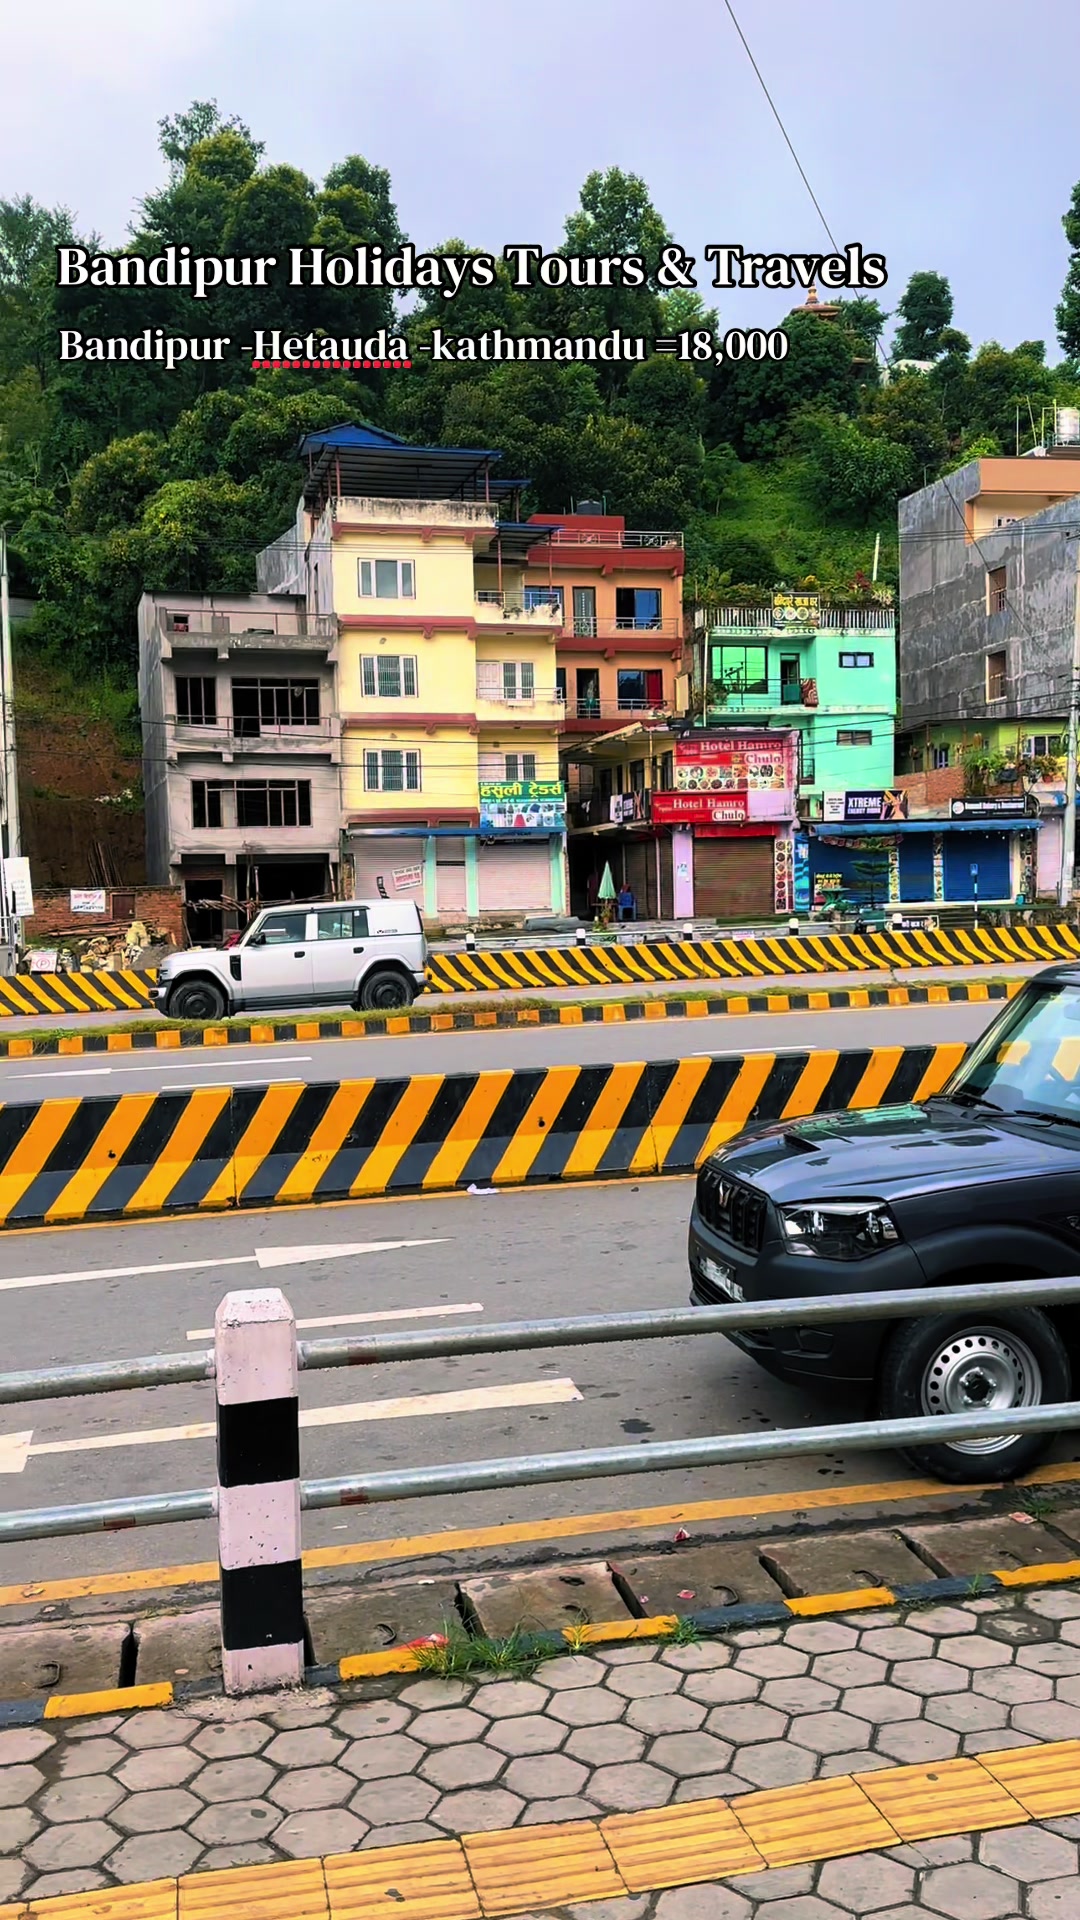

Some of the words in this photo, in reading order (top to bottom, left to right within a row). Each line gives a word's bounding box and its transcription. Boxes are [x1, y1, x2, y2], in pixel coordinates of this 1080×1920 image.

[701, 740, 734, 751] Hotel
[738, 740, 782, 751] Hamro
[746, 754, 782, 764] Chulo
[673, 798, 703, 809] Hotel
[707, 798, 745, 809] Hamro
[848, 797, 882, 808] XTREME
[713, 811, 744, 820] Chulo
